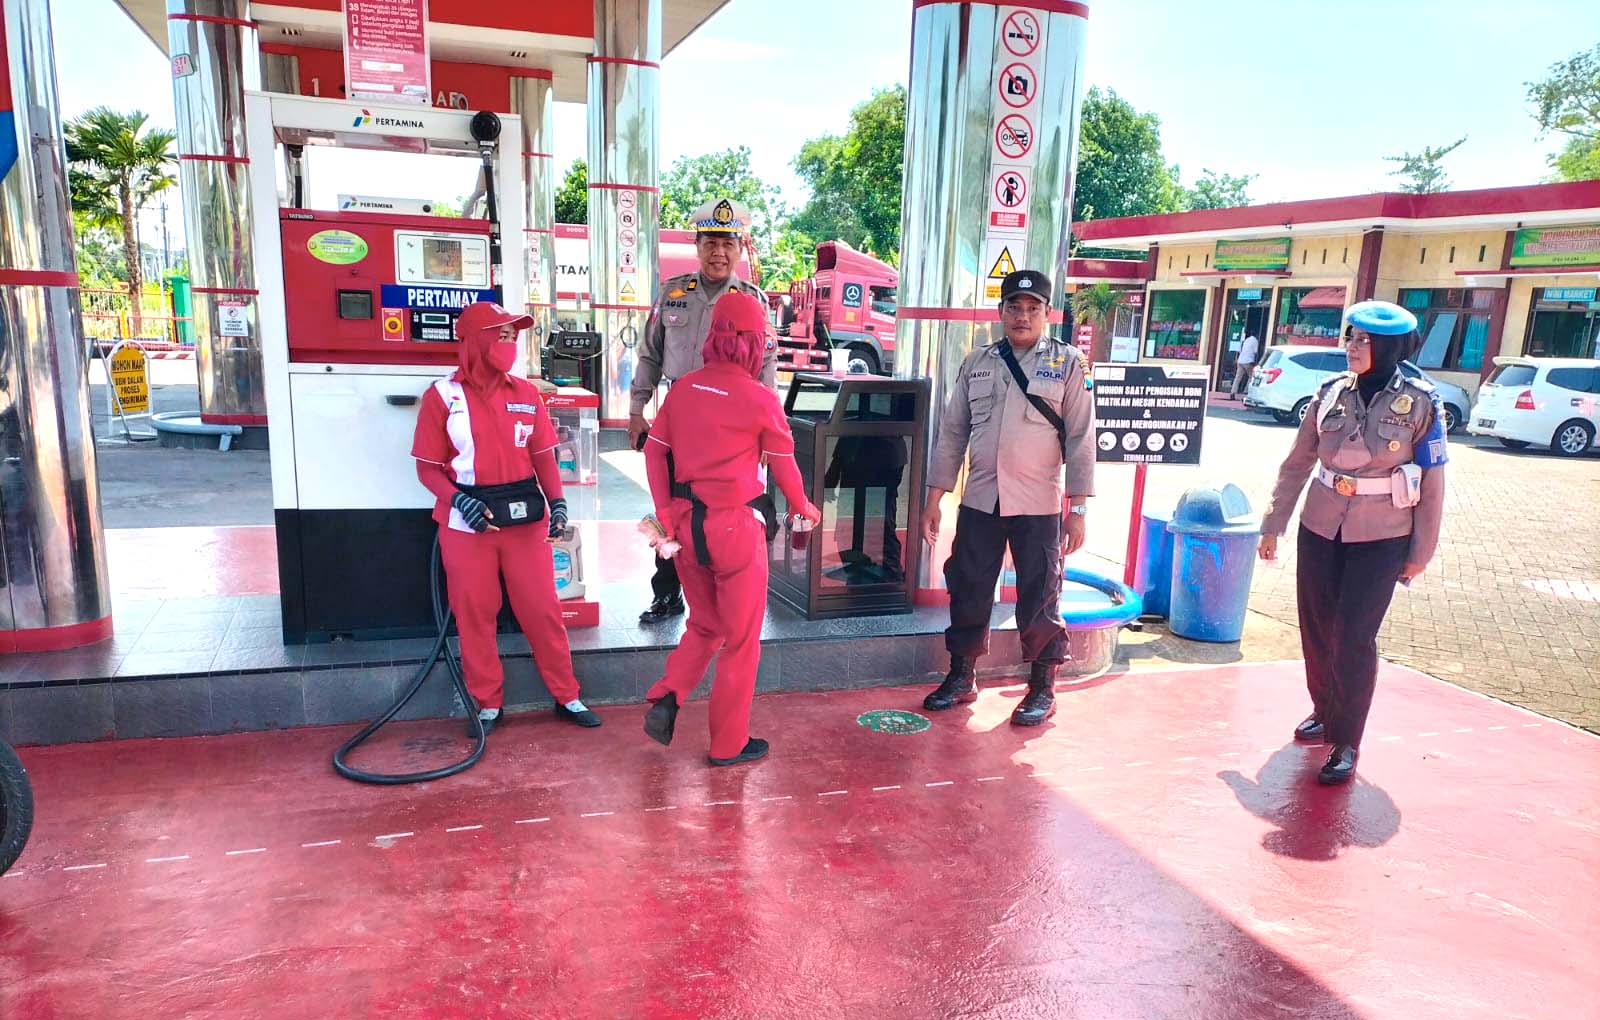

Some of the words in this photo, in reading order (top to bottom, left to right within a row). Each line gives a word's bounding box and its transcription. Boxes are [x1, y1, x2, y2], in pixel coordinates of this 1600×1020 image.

[375, 117, 425, 128] PERTAMINA
[407, 288, 479, 308] PERTAMAX
[1546, 289, 1562, 299] MINI
[1563, 289, 1594, 299] MARKET
[666, 300, 688, 309] AGUS
[127, 376, 144, 385] DALAM
[120, 385, 140, 394] PROSES
[1096, 385, 1124, 395] MOHON
[1125, 385, 1144, 395] SAAT
[1145, 386, 1184, 396] PENGISIAN
[1184, 387, 1202, 397] BBM
[1096, 397, 1131, 406] MATIKAN
[1131, 397, 1156, 407] MESIN
[1156, 398, 1200, 408] KENDARAAN
[1143, 409, 1152, 419] &
[1095, 418, 1131, 429] DILARANG
[1131, 419, 1186, 430] MENGGUNAKAN
[1187, 420, 1198, 431] HP
[1123, 453, 1144, 462] TERIMA
[1145, 453, 1163, 463] KASIH
